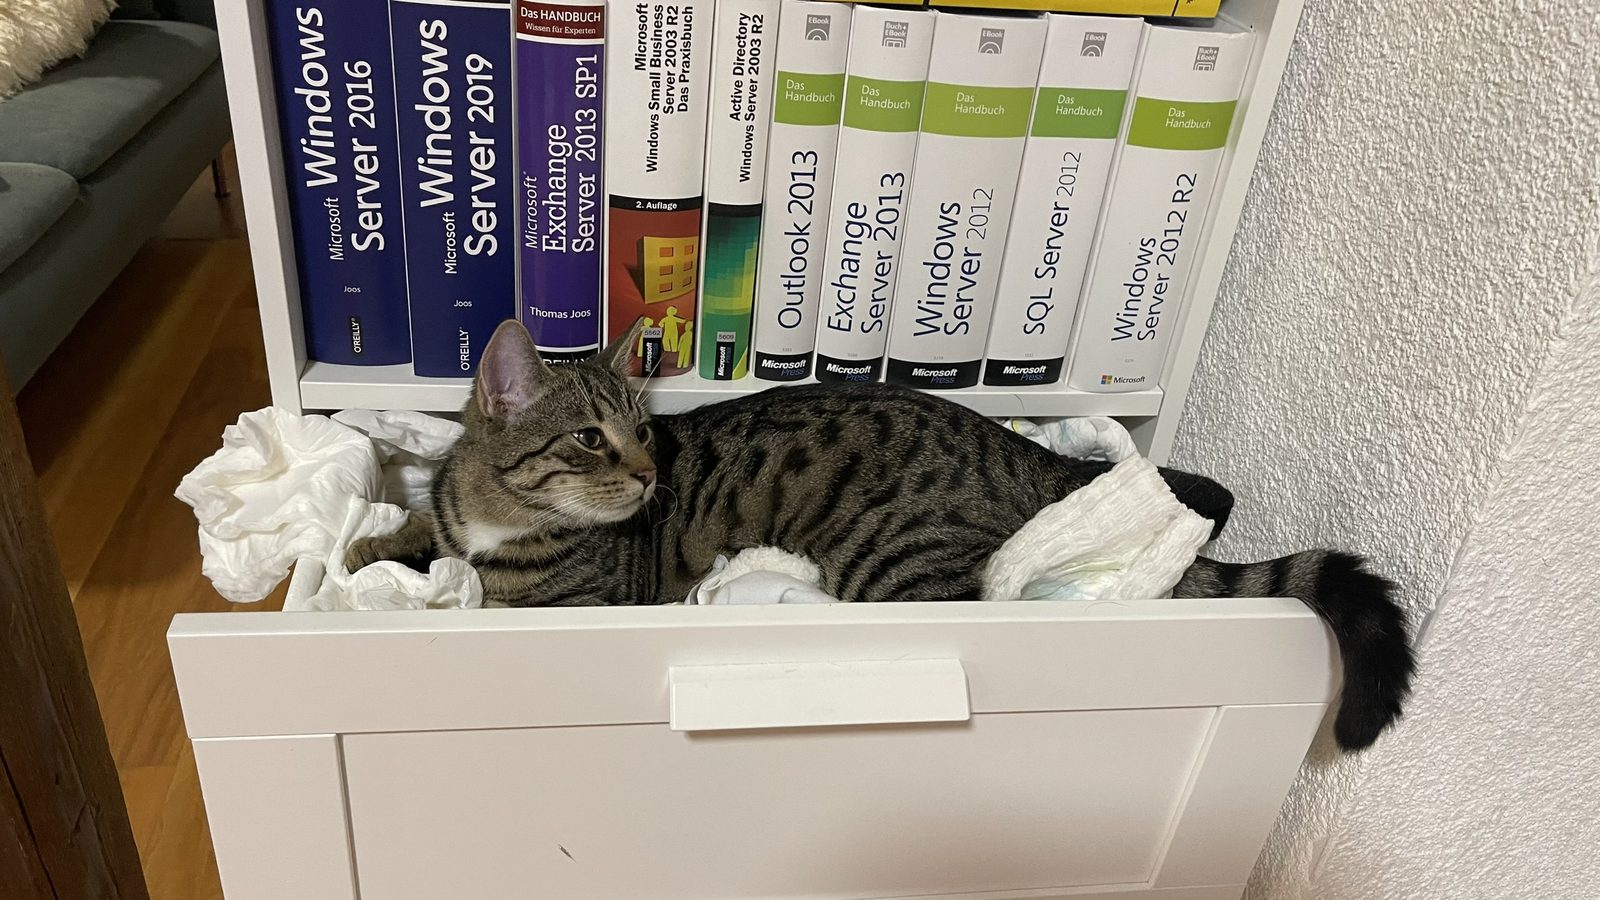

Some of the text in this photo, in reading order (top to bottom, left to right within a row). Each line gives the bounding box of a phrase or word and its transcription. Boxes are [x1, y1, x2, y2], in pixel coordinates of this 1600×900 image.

[521, 8, 601, 22] Das HANDBUCH
[525, 22, 596, 36] Wissen für Experten
[635, 2, 648, 71] Microsoft
[663, 5, 679, 115] Server 2003 R2
[678, 6, 693, 112] Das Praxisbuch
[729, 12, 751, 121] Active Directory
[646, 4, 664, 172] Windows Small Business
[786, 79, 805, 91] Das
[861, 85, 880, 96] Das
[739, 14, 764, 182] Windows Server 2003 R2
[785, 90, 835, 103] Handbuch
[860, 96, 911, 110] Handbuch
[956, 92, 975, 103] Das
[1058, 95, 1074, 105] Das
[955, 103, 1005, 116] Handbuch
[1055, 105, 1103, 117] Handbuch
[1168, 108, 1186, 118] Das
[1165, 118, 1212, 129] Handbuch
[295, 7, 344, 261] Microsoft Windows
[415, 19, 458, 274] Microsoft Windows
[572, 54, 598, 252] Server 2013 SP1
[344, 60, 384, 251] Server 2016
[465, 53, 498, 256] Server 2019
[542, 124, 572, 253] Exchange
[525, 176, 538, 248] Microsoft
[636, 201, 678, 211] 2. Auflage
[778, 150, 818, 329] Outlook 2013
[1023, 151, 1082, 336] SQL Server 2012
[861, 171, 905, 334] Server 2013
[1137, 172, 1198, 341] Server 2012 R2
[828, 202, 872, 333] Exchange
[943, 188, 994, 336] Server 2012
[913, 201, 961, 338] Windows
[1111, 237, 1157, 342] Windows
[453, 299, 472, 308] Joos
[530, 306, 591, 319] Thomas Joos
[645, 342, 653, 372] Microsoft
[718, 346, 726, 377] Microsoft
[761, 358, 806, 371] Microsoft
[781, 367, 804, 376] Press
[826, 362, 871, 375] Microsoft
[1002, 365, 1046, 375] Microsoft
[845, 372, 869, 382] Press
[912, 368, 957, 378] Microsoft
[931, 376, 955, 384] Press
[1020, 373, 1044, 382] Press
[1113, 375, 1146, 384] Microsoft
